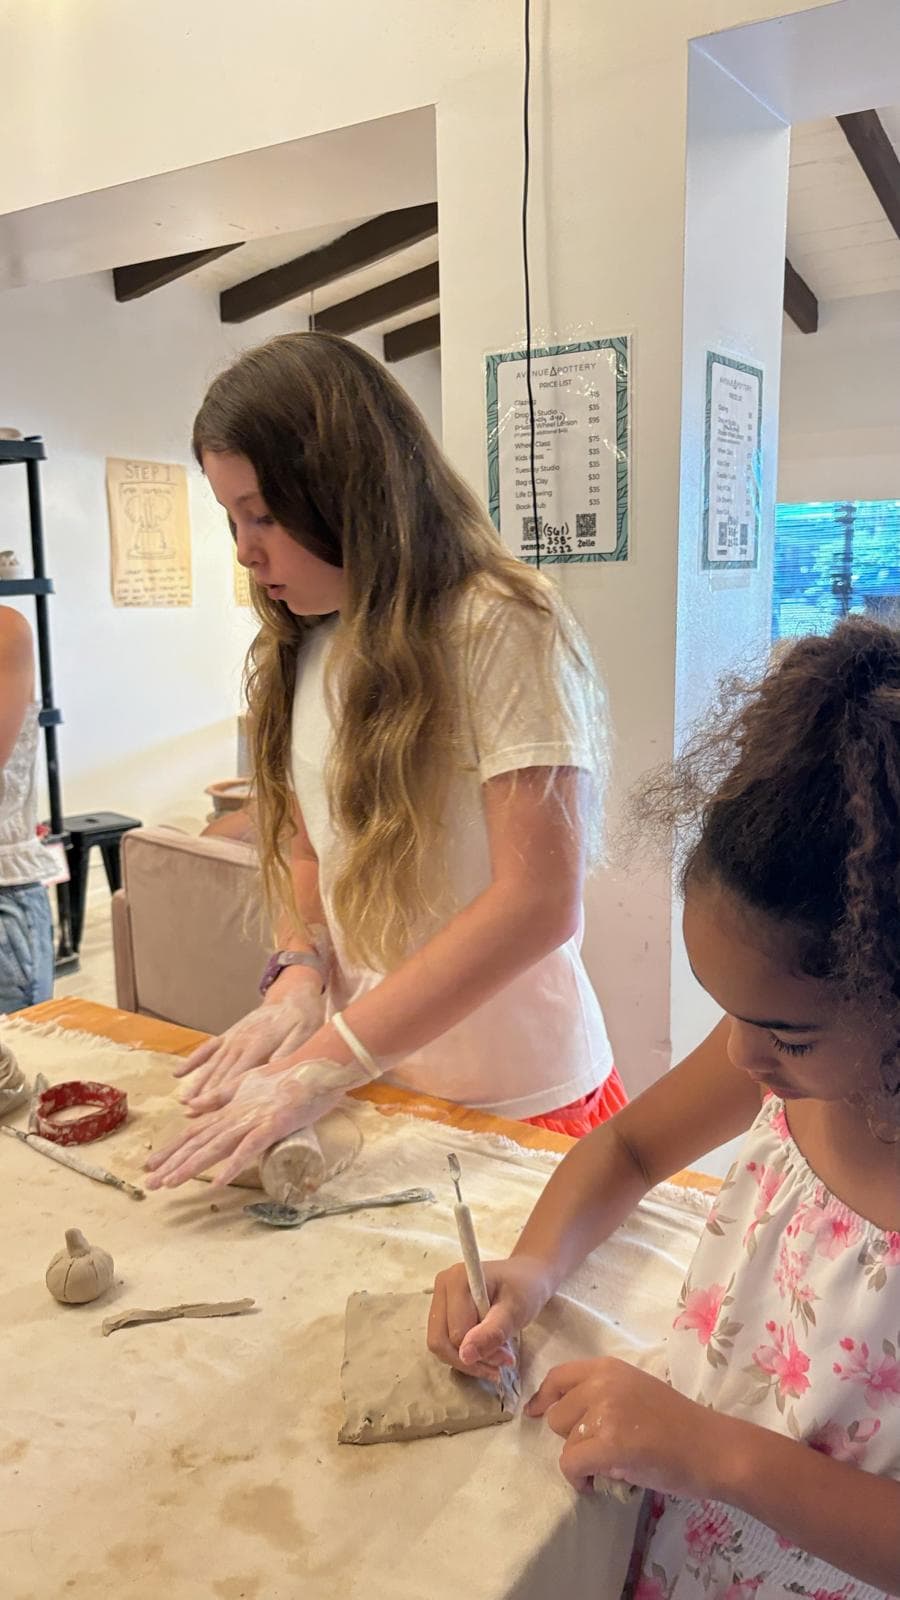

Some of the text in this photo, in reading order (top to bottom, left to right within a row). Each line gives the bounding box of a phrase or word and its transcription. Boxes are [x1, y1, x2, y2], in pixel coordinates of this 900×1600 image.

[516, 363, 597, 379] AVNUE POTTERY
[539, 379, 572, 389] PRICE LIST
[589, 403, 600, 411] $35
[589, 416, 600, 424] $95
[536, 420, 556, 429] Wheel
[589, 435, 600, 443] $75
[535, 440, 551, 448] Class
[589, 447, 600, 455] $35
[540, 464, 560, 472] Studio
[589, 460, 600, 468] $35
[124, 462, 160, 480] STEP
[589, 473, 600, 481] $30
[515, 479, 528, 487] Bag
[535, 478, 548, 486] Clay
[527, 490, 552, 498] Dwing
[577, 539, 596, 548] Zelle
